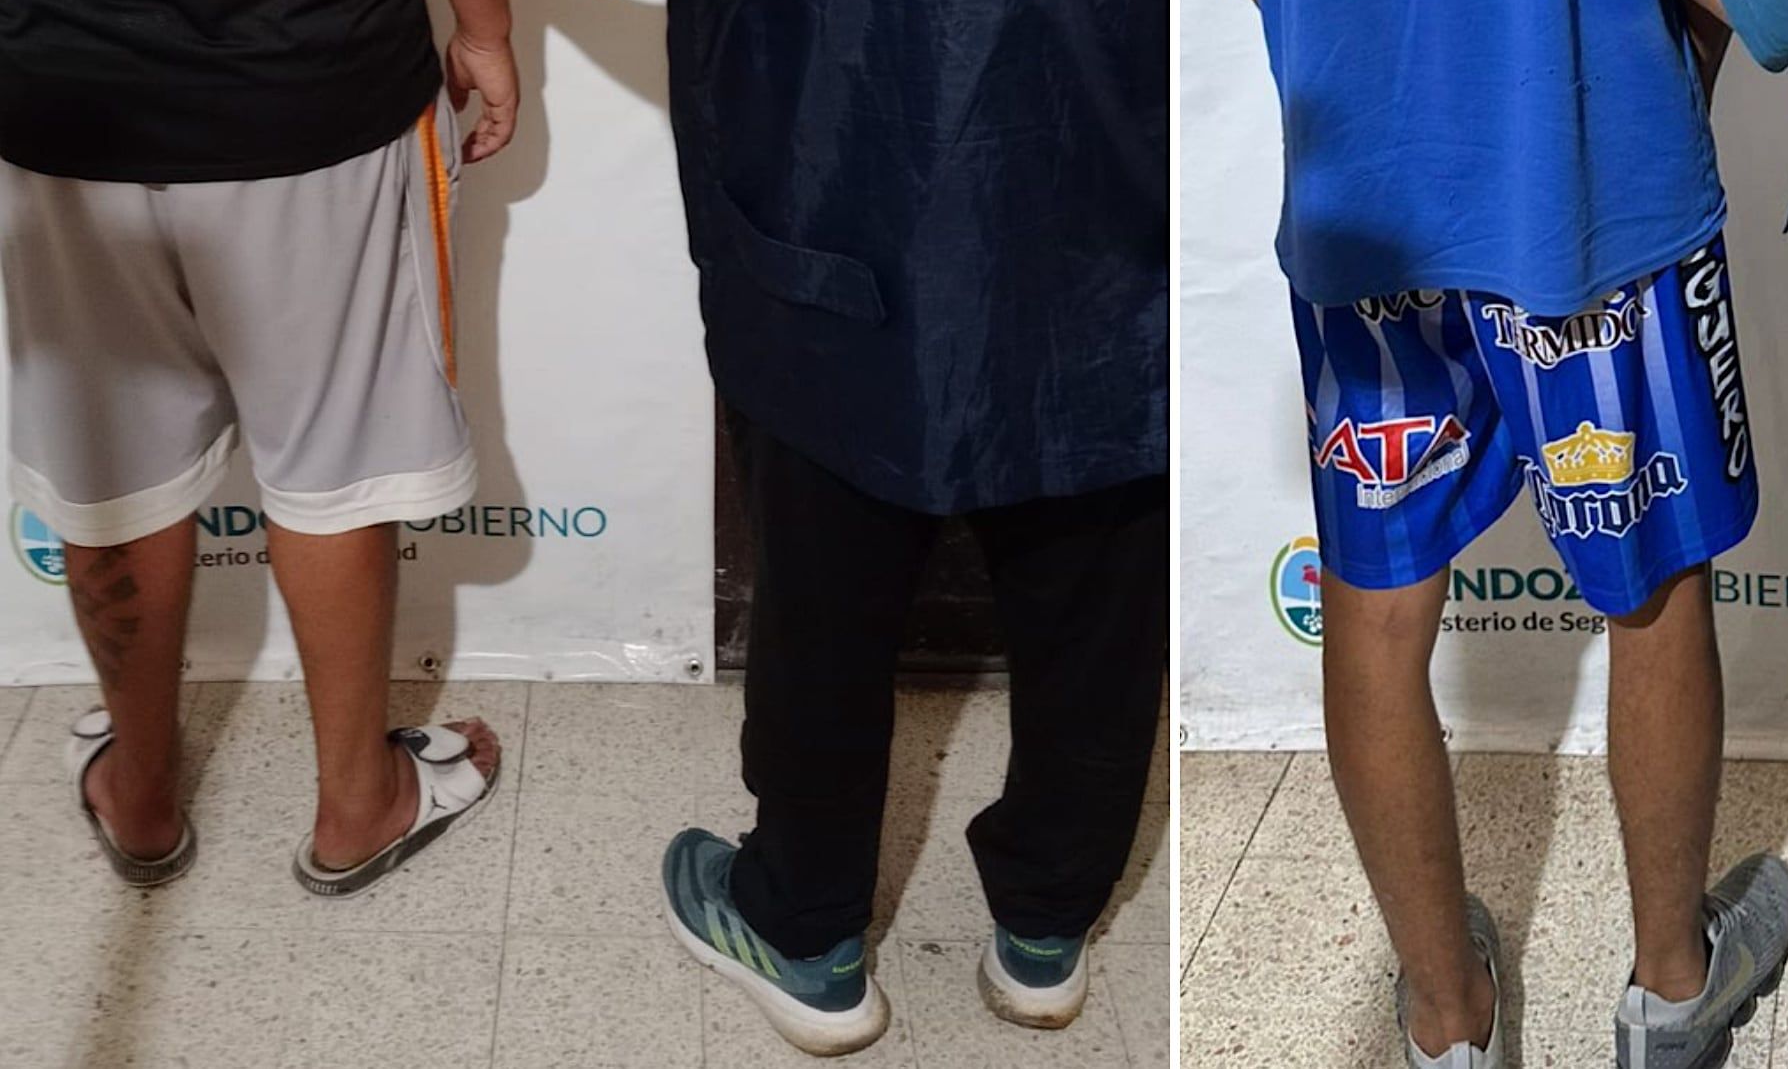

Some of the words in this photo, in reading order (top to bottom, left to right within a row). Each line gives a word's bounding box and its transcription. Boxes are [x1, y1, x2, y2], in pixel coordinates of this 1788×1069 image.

[1684, 248, 1748, 478] GUERO
[1313, 414, 1472, 485] ATA
[1522, 611, 1554, 632] de
